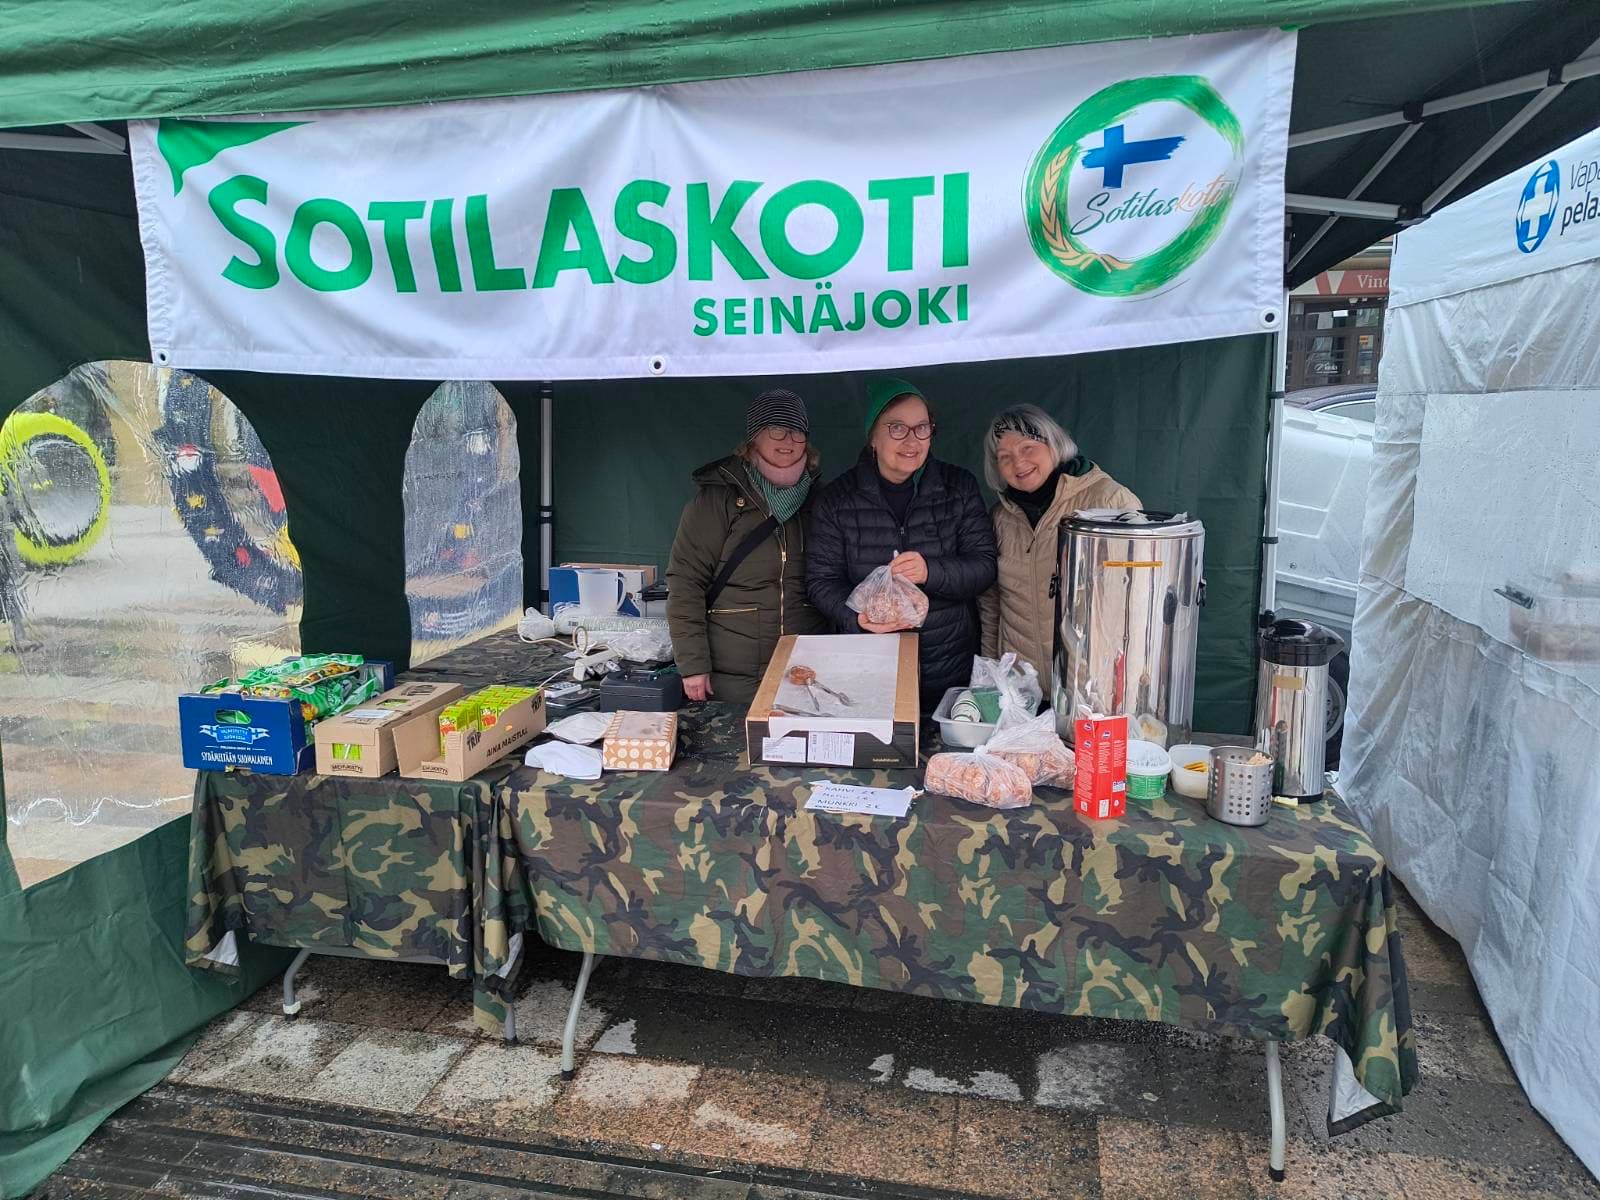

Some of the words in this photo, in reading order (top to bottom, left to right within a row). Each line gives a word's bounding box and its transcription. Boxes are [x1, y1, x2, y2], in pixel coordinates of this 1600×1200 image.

[1070, 173, 1233, 235] Sotilaskoti
[1559, 191, 1600, 236] pela
[208, 172, 970, 293] SOTILASKOTI
[693, 282, 969, 336] SEINÄJOKI
[466, 730, 482, 752] TRIP
[486, 743, 501, 757] AINA
